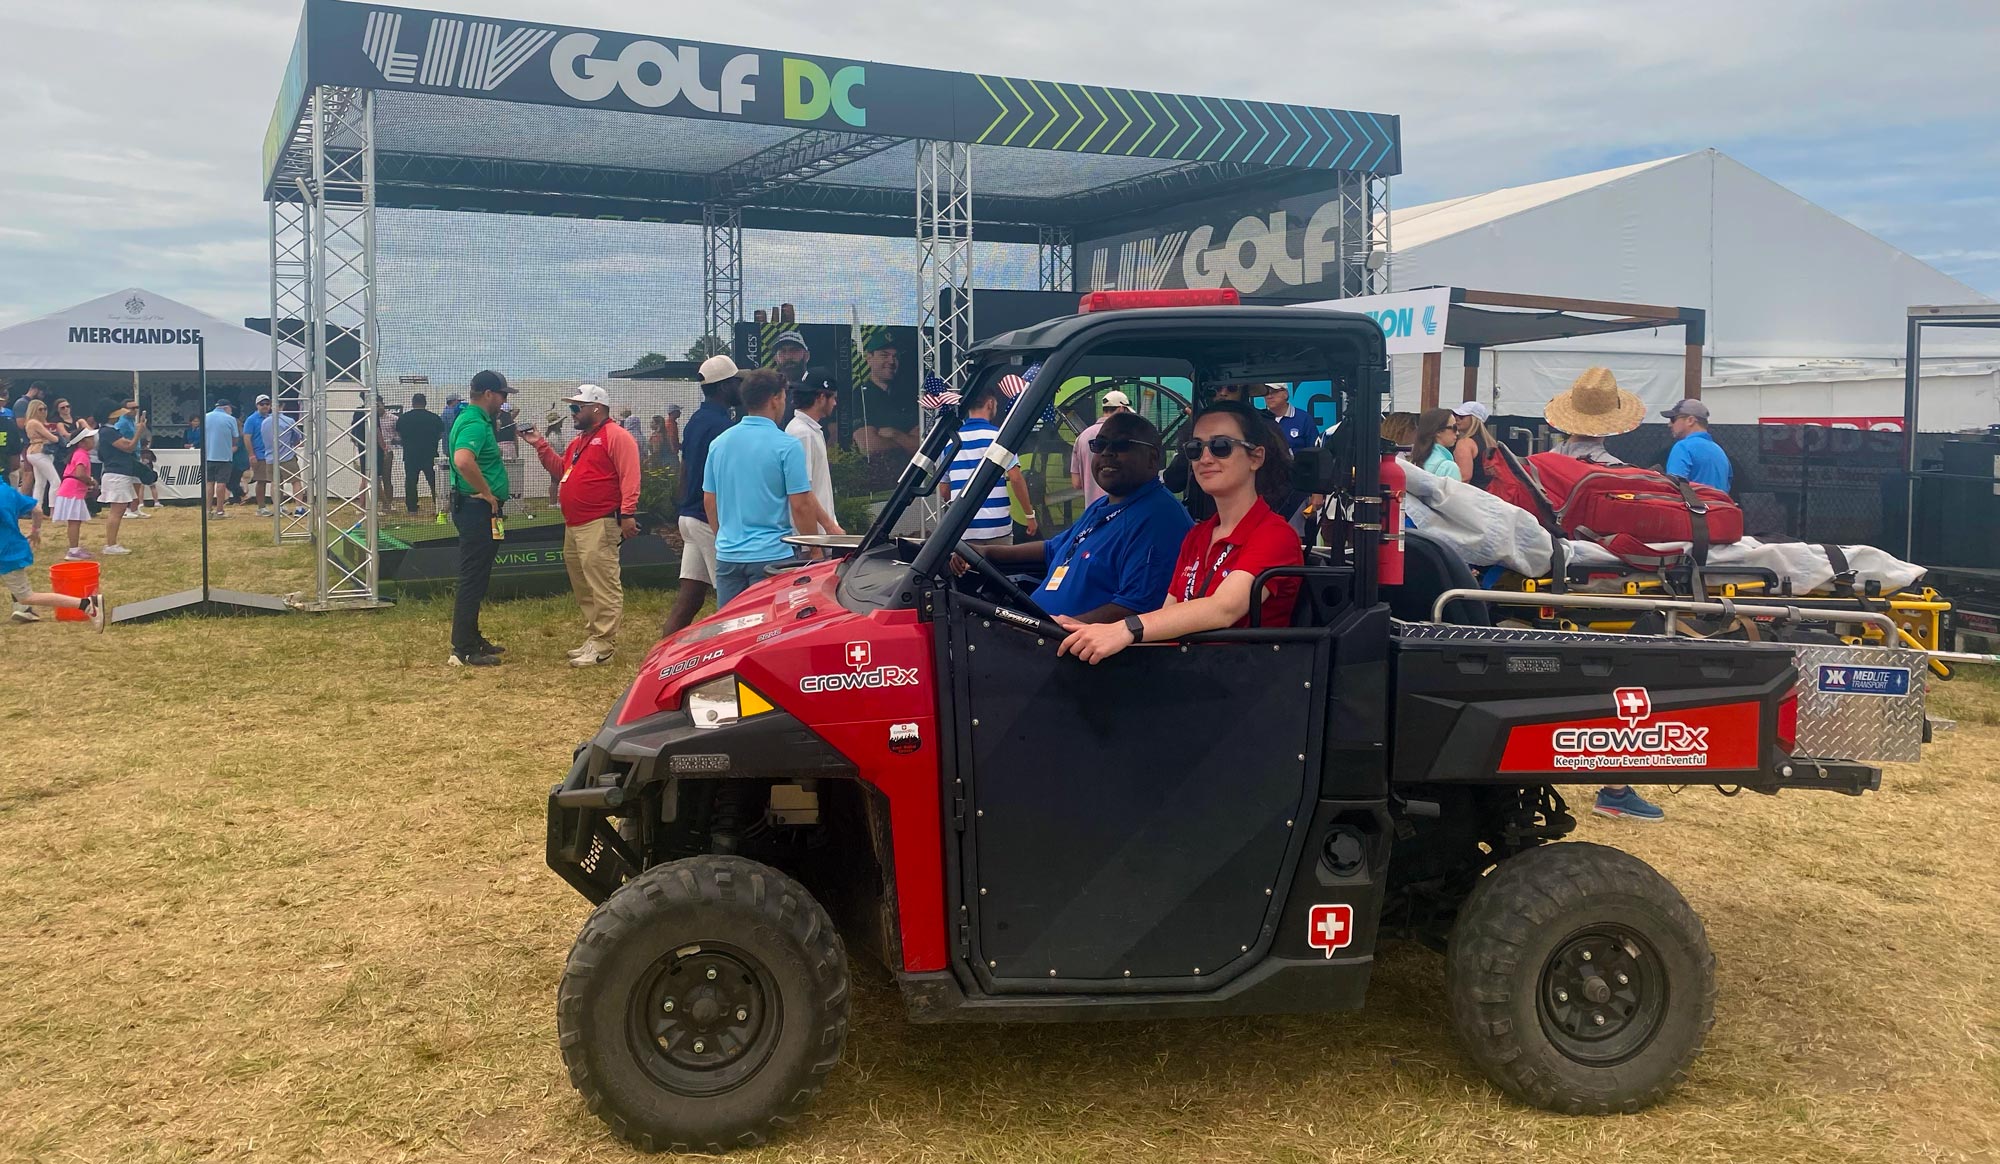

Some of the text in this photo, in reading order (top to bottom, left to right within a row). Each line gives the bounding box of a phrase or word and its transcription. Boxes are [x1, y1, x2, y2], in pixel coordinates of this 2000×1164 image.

[362, 11, 866, 127] LIV GOLF DC
[1091, 198, 1340, 294] LIV GOLF
[68, 327, 201, 344] MERCHANDISE
[494, 553, 538, 565] WING
[658, 656, 700, 680] 900
[1853, 670, 1891, 682] MEDLITE
[800, 665, 919, 693] crowdRx
[1851, 680, 1888, 689] TRANSPORT
[1553, 722, 1709, 752] crowdRx
[1555, 755, 1707, 769] Keeping Your Event UnEventful
